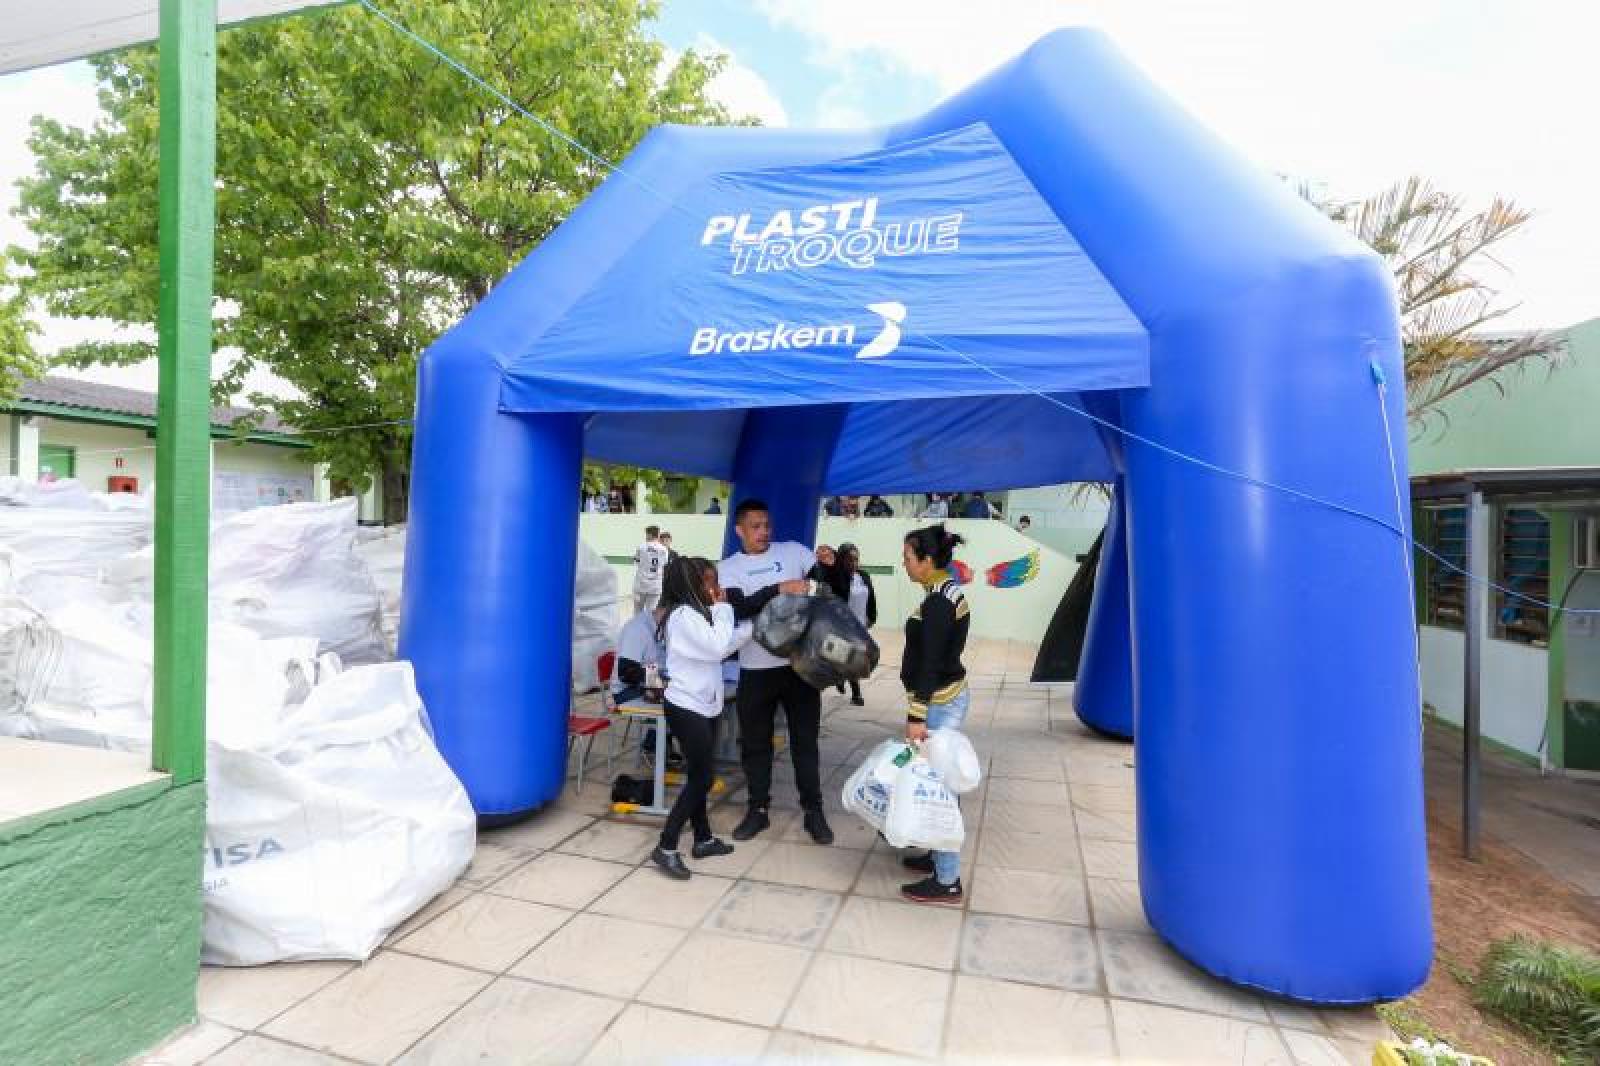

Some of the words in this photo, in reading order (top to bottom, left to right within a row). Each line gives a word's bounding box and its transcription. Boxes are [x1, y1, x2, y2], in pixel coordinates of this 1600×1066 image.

[701, 196, 879, 246] PLASTI
[729, 213, 964, 275] TROQUE
[689, 322, 856, 356] Braskem
[202, 838, 285, 869] ISA
